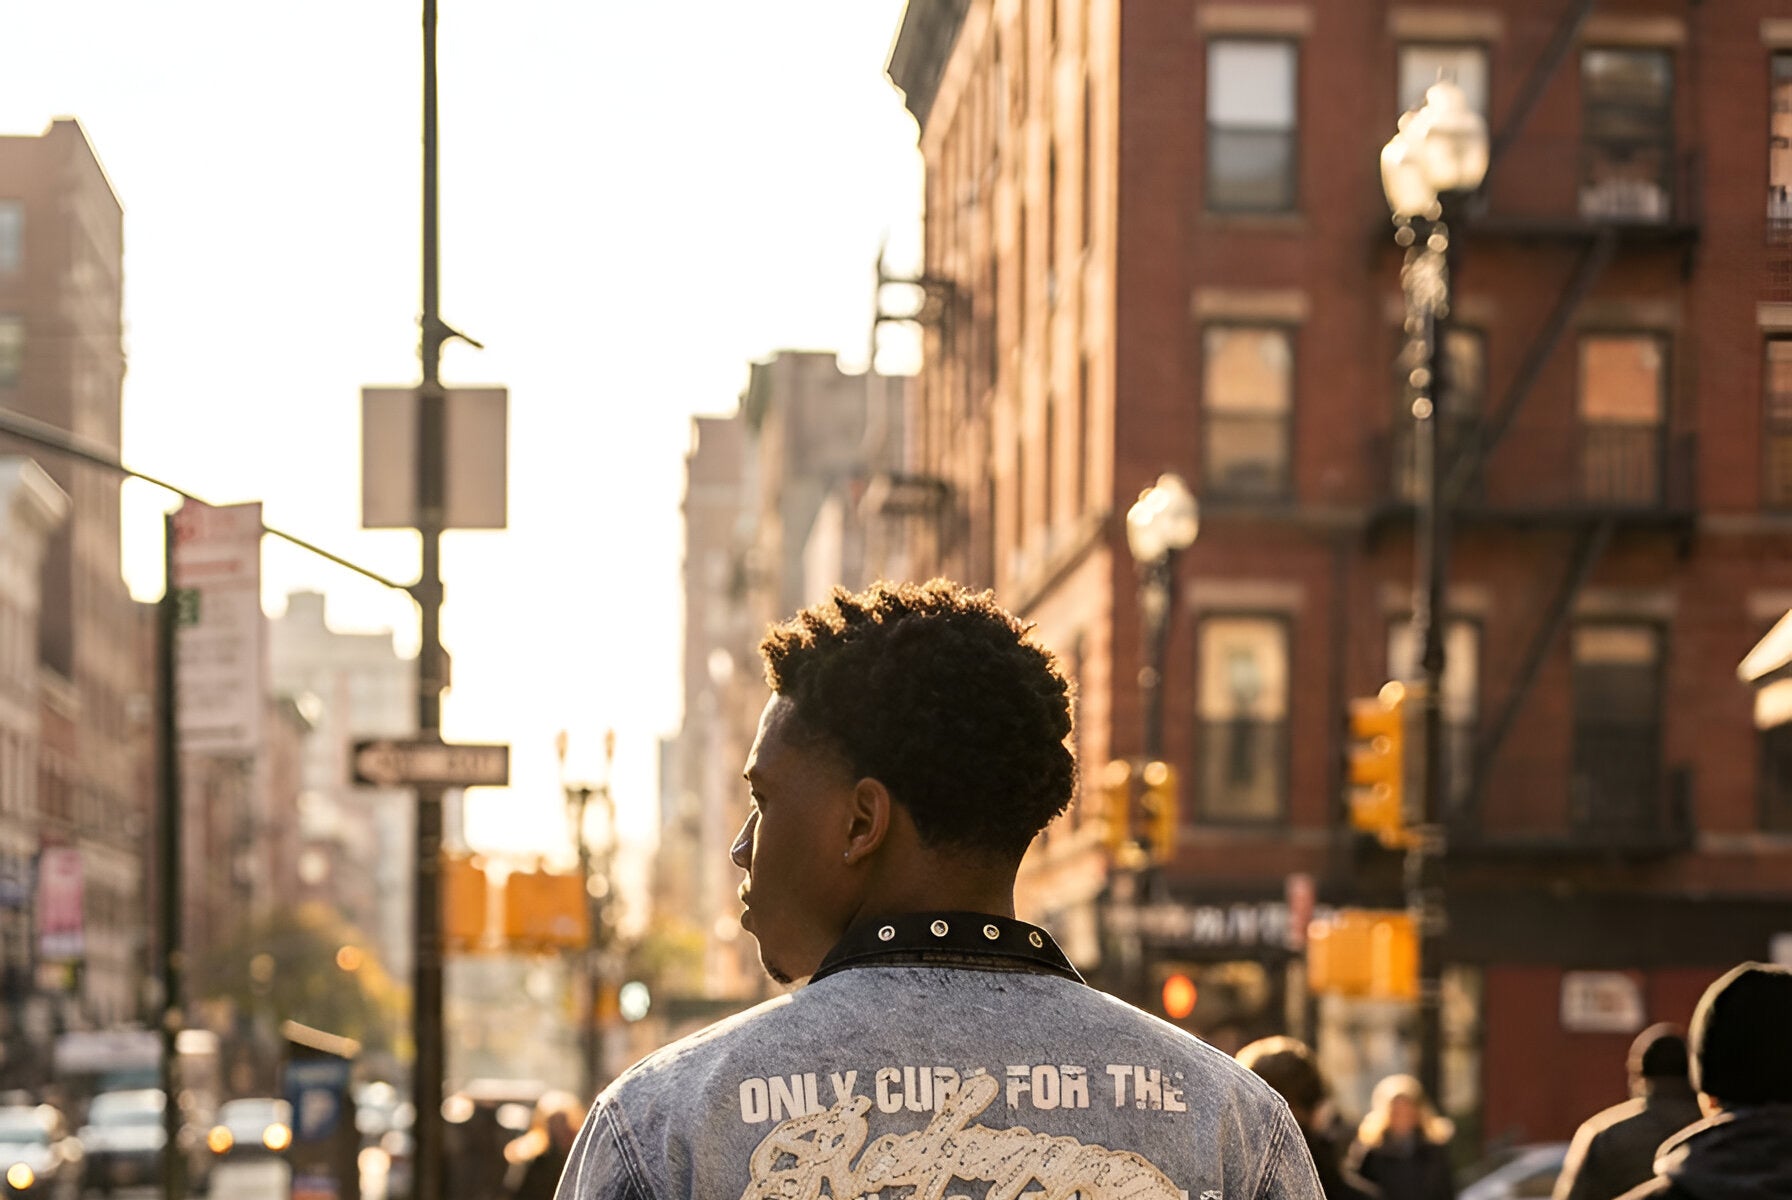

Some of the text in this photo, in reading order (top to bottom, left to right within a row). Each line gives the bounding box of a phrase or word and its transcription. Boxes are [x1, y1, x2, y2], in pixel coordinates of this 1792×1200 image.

[739, 1064, 1187, 1123] ONLY CUR FOR THE
